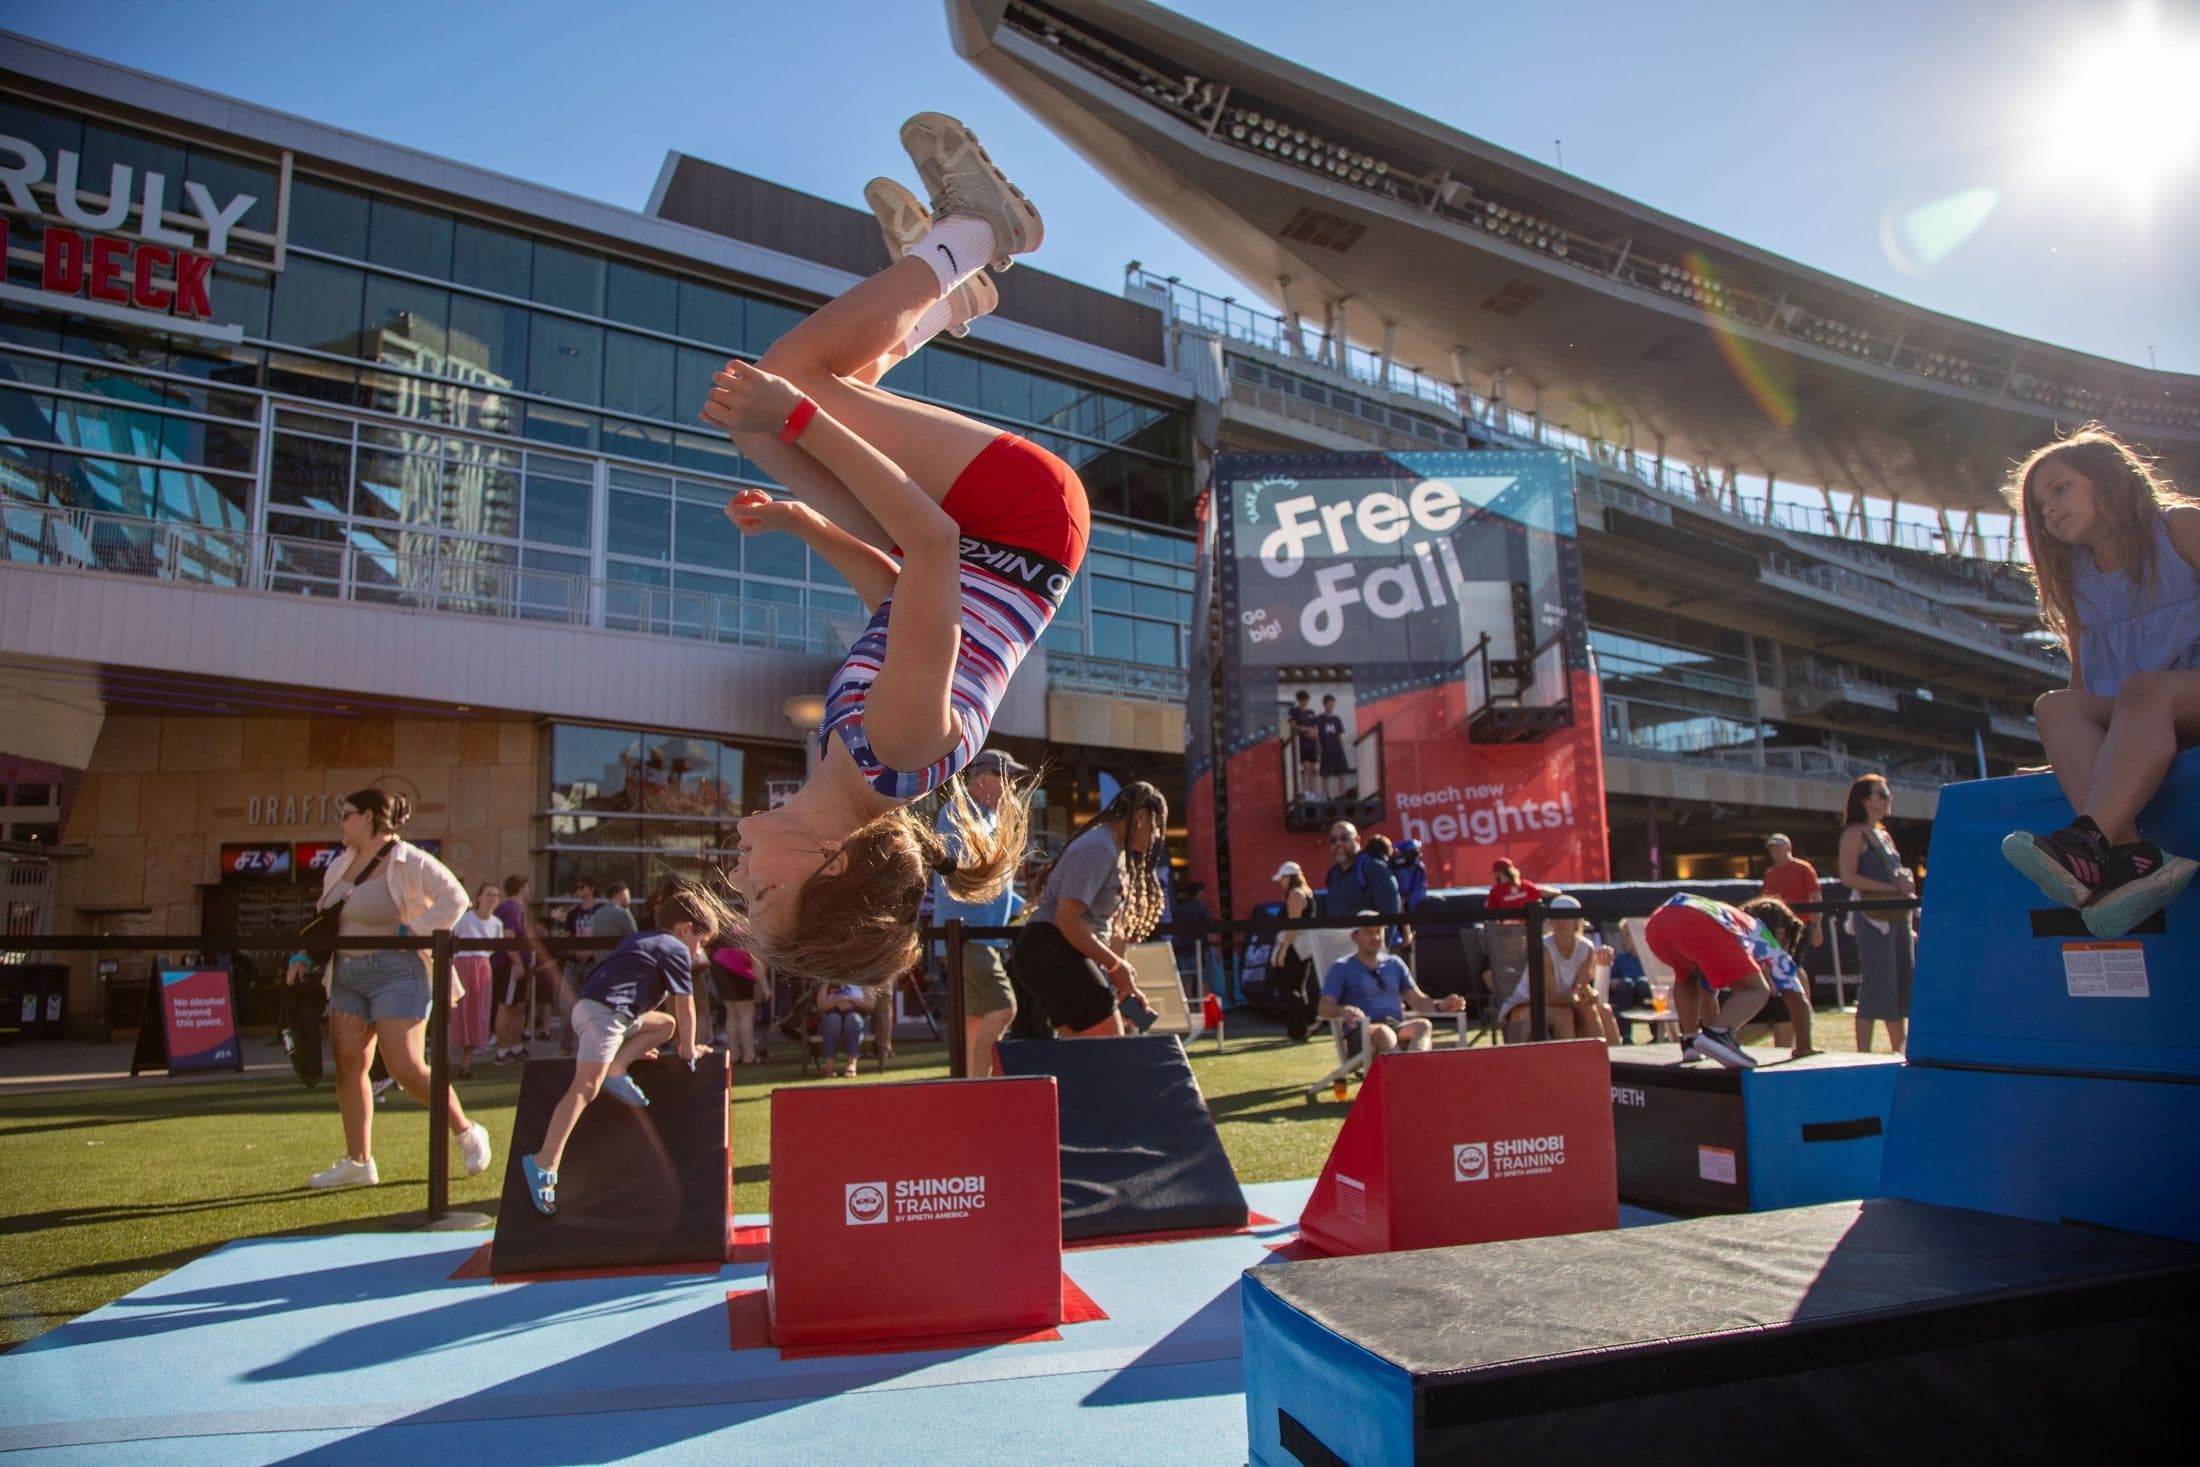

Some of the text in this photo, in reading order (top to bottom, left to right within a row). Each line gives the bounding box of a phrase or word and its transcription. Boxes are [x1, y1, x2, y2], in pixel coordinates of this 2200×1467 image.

[43, 226, 216, 319] DECK
[1260, 479, 1462, 578] Free
[960, 537, 1044, 582] NIKE
[1300, 536, 1464, 647] Fall
[1241, 608, 1266, 625] Go
[1248, 619, 1282, 643] big!
[1396, 783, 1504, 808] Reach new
[248, 795, 345, 825] DRAFTS
[1400, 791, 1575, 845] heights!
[174, 997, 225, 1007] No alcohol
[175, 1008, 211, 1019] beyond
[176, 1018, 194, 1028] this
[1611, 1087, 1645, 1107] PIETH
[1493, 1135, 1564, 1156] SHINOBI
[1494, 1152, 1565, 1171] TRAINING
[895, 1175, 985, 1198] SHINOBI
[895, 1194, 985, 1214] TRAINING
[895, 1211, 969, 1223] BY SPIETH AMERICA
